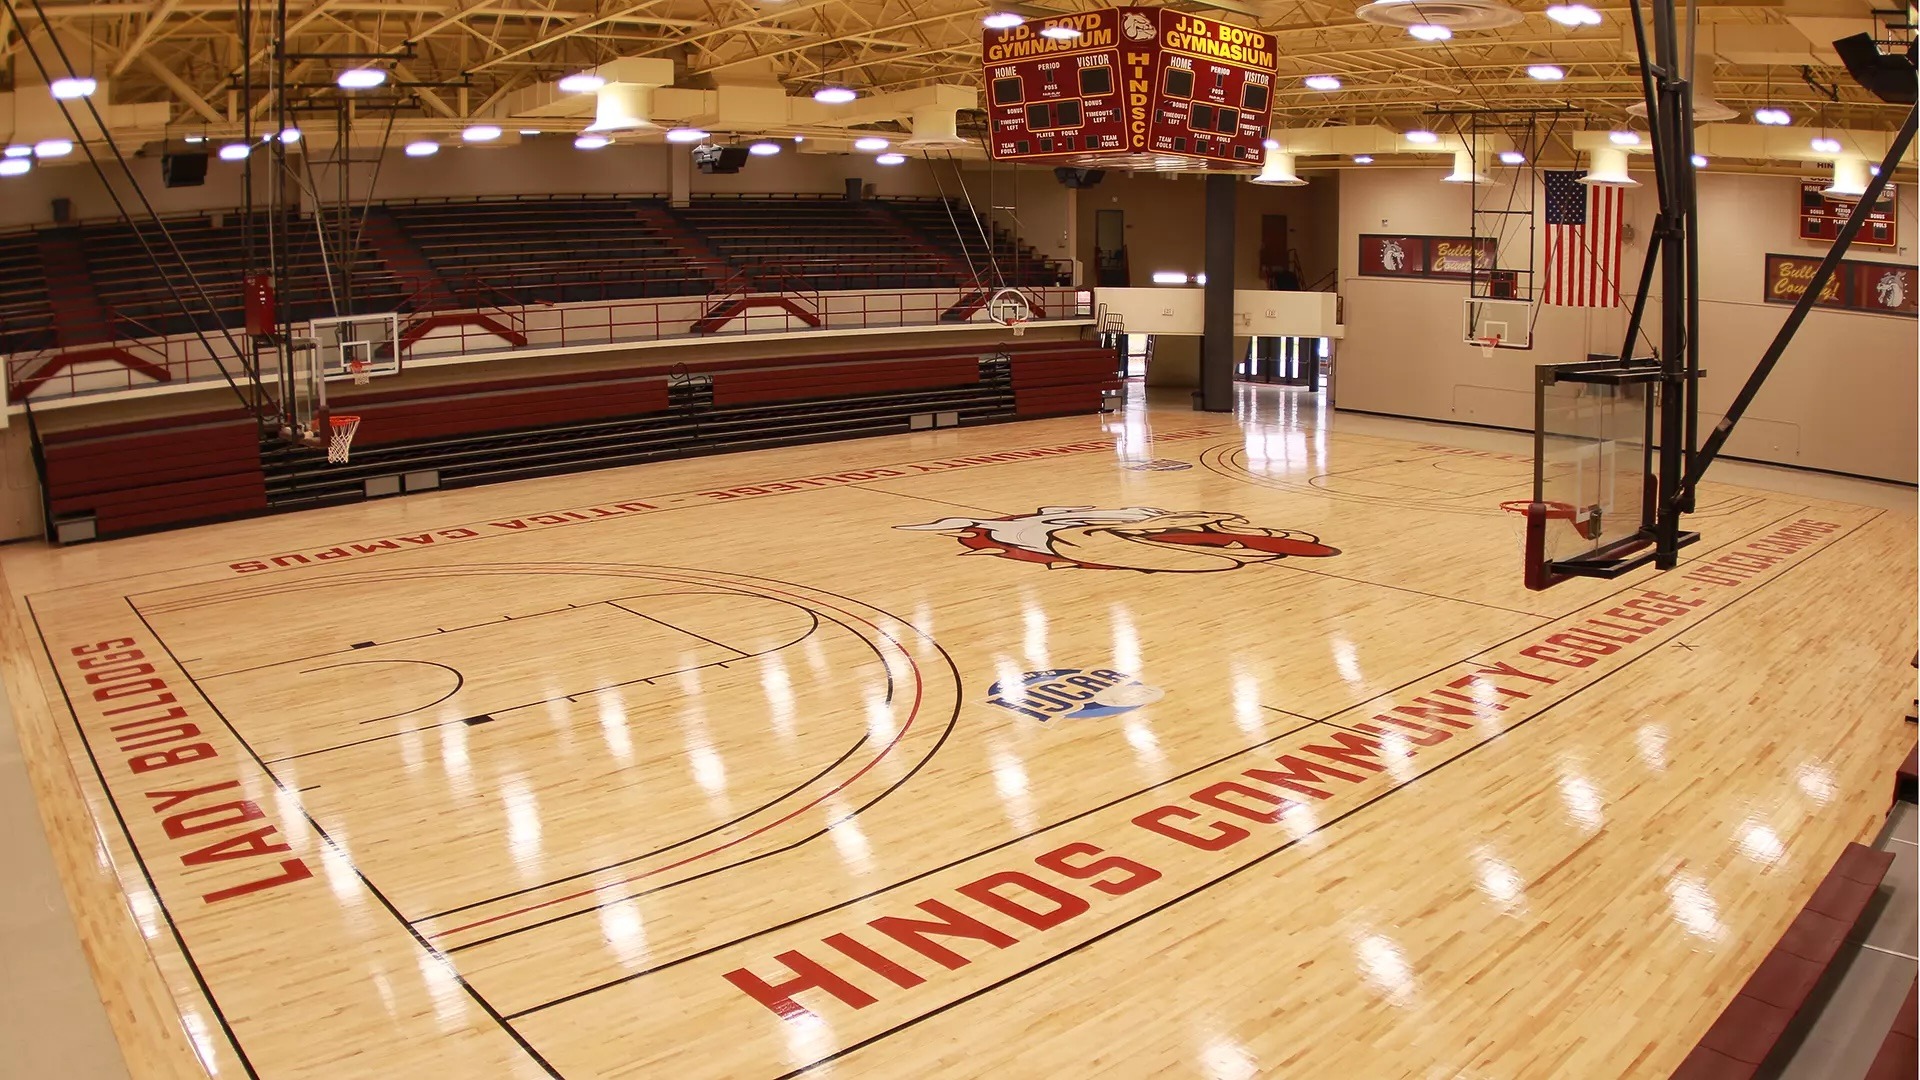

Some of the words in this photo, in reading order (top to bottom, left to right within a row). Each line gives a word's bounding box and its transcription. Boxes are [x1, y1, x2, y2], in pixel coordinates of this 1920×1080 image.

[998, 25, 1035, 43] J.D.
[1044, 13, 1101, 33] BOYD
[1176, 16, 1211, 37] J.D.
[1219, 25, 1265, 49] BOYD
[989, 29, 1111, 60] GYMNASIUM
[1166, 31, 1273, 67] GYMNASIUM
[1038, 62, 1060, 70] PERIOD
[1077, 54, 1109, 67] VISITOR
[1170, 56, 1192, 70] HOME
[1210, 66, 1231, 76] PERIOD
[995, 66, 1017, 77] HOME
[1244, 71, 1269, 84] VISITOR
[1084, 99, 1102, 107] BONUS
[1172, 101, 1188, 109] BONUS
[1163, 111, 1187, 120] TIMEOUTS
[1240, 123, 1261, 132] TIMEOUTS
[696, 469, 906, 500] COLLEGE
[488, 501, 658, 530] UTICA
[229, 528, 480, 574] CAMPUS
[71, 637, 219, 775] BULLDOGS
[721, 842, 1163, 1020] HINDS
[1131, 660, 1559, 852] COMMUNITY
[1518, 590, 1706, 669] COLLEGE
[1681, 552, 1785, 587] UTICA
[1746, 518, 1842, 555] CAMPUS
[144, 779, 314, 904] LADY
